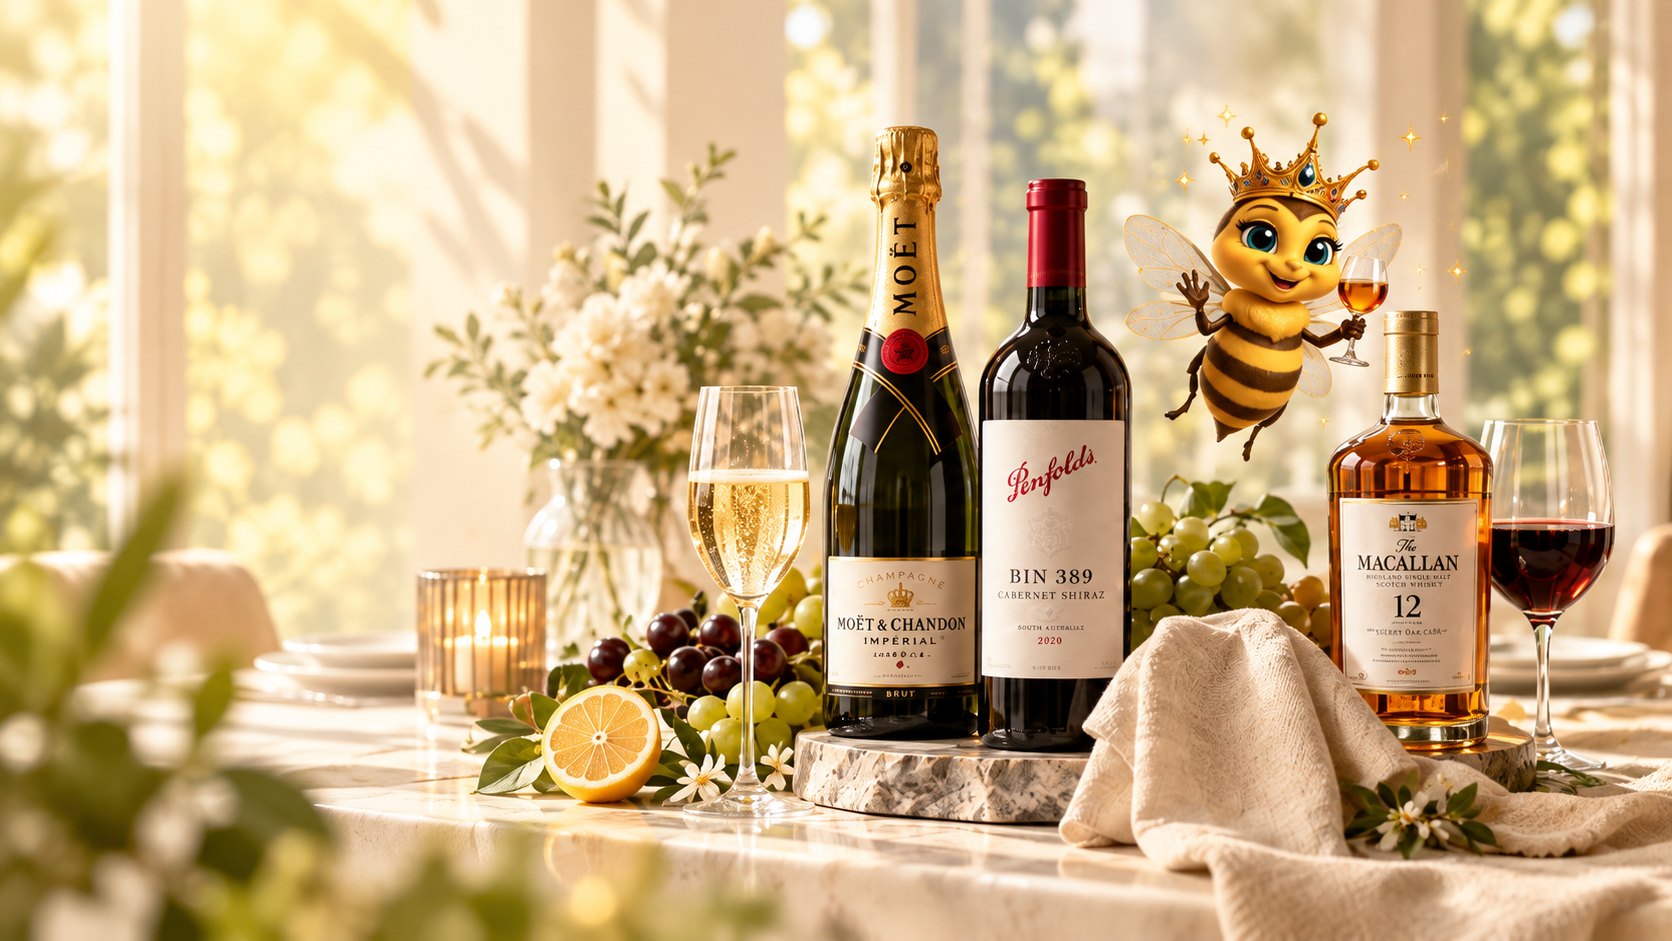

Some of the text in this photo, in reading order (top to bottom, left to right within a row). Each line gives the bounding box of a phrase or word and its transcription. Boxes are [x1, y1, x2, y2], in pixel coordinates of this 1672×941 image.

[890, 217, 916, 316] MOËT
[1395, 538, 1417, 553] The
[1357, 554, 1459, 571] MACALLAN
[857, 571, 945, 590] CHAMPAGNE
[1009, 568, 1093, 584] BIN 389
[997, 590, 1105, 600] CABERNET SHIRAZ
[1393, 594, 1422, 618] 12
[837, 614, 967, 631] MOËT & CHANDON
[864, 634, 937, 645] IMPÉRIAL
[1037, 636, 1063, 645] 2020
[886, 690, 916, 698] BRUT
